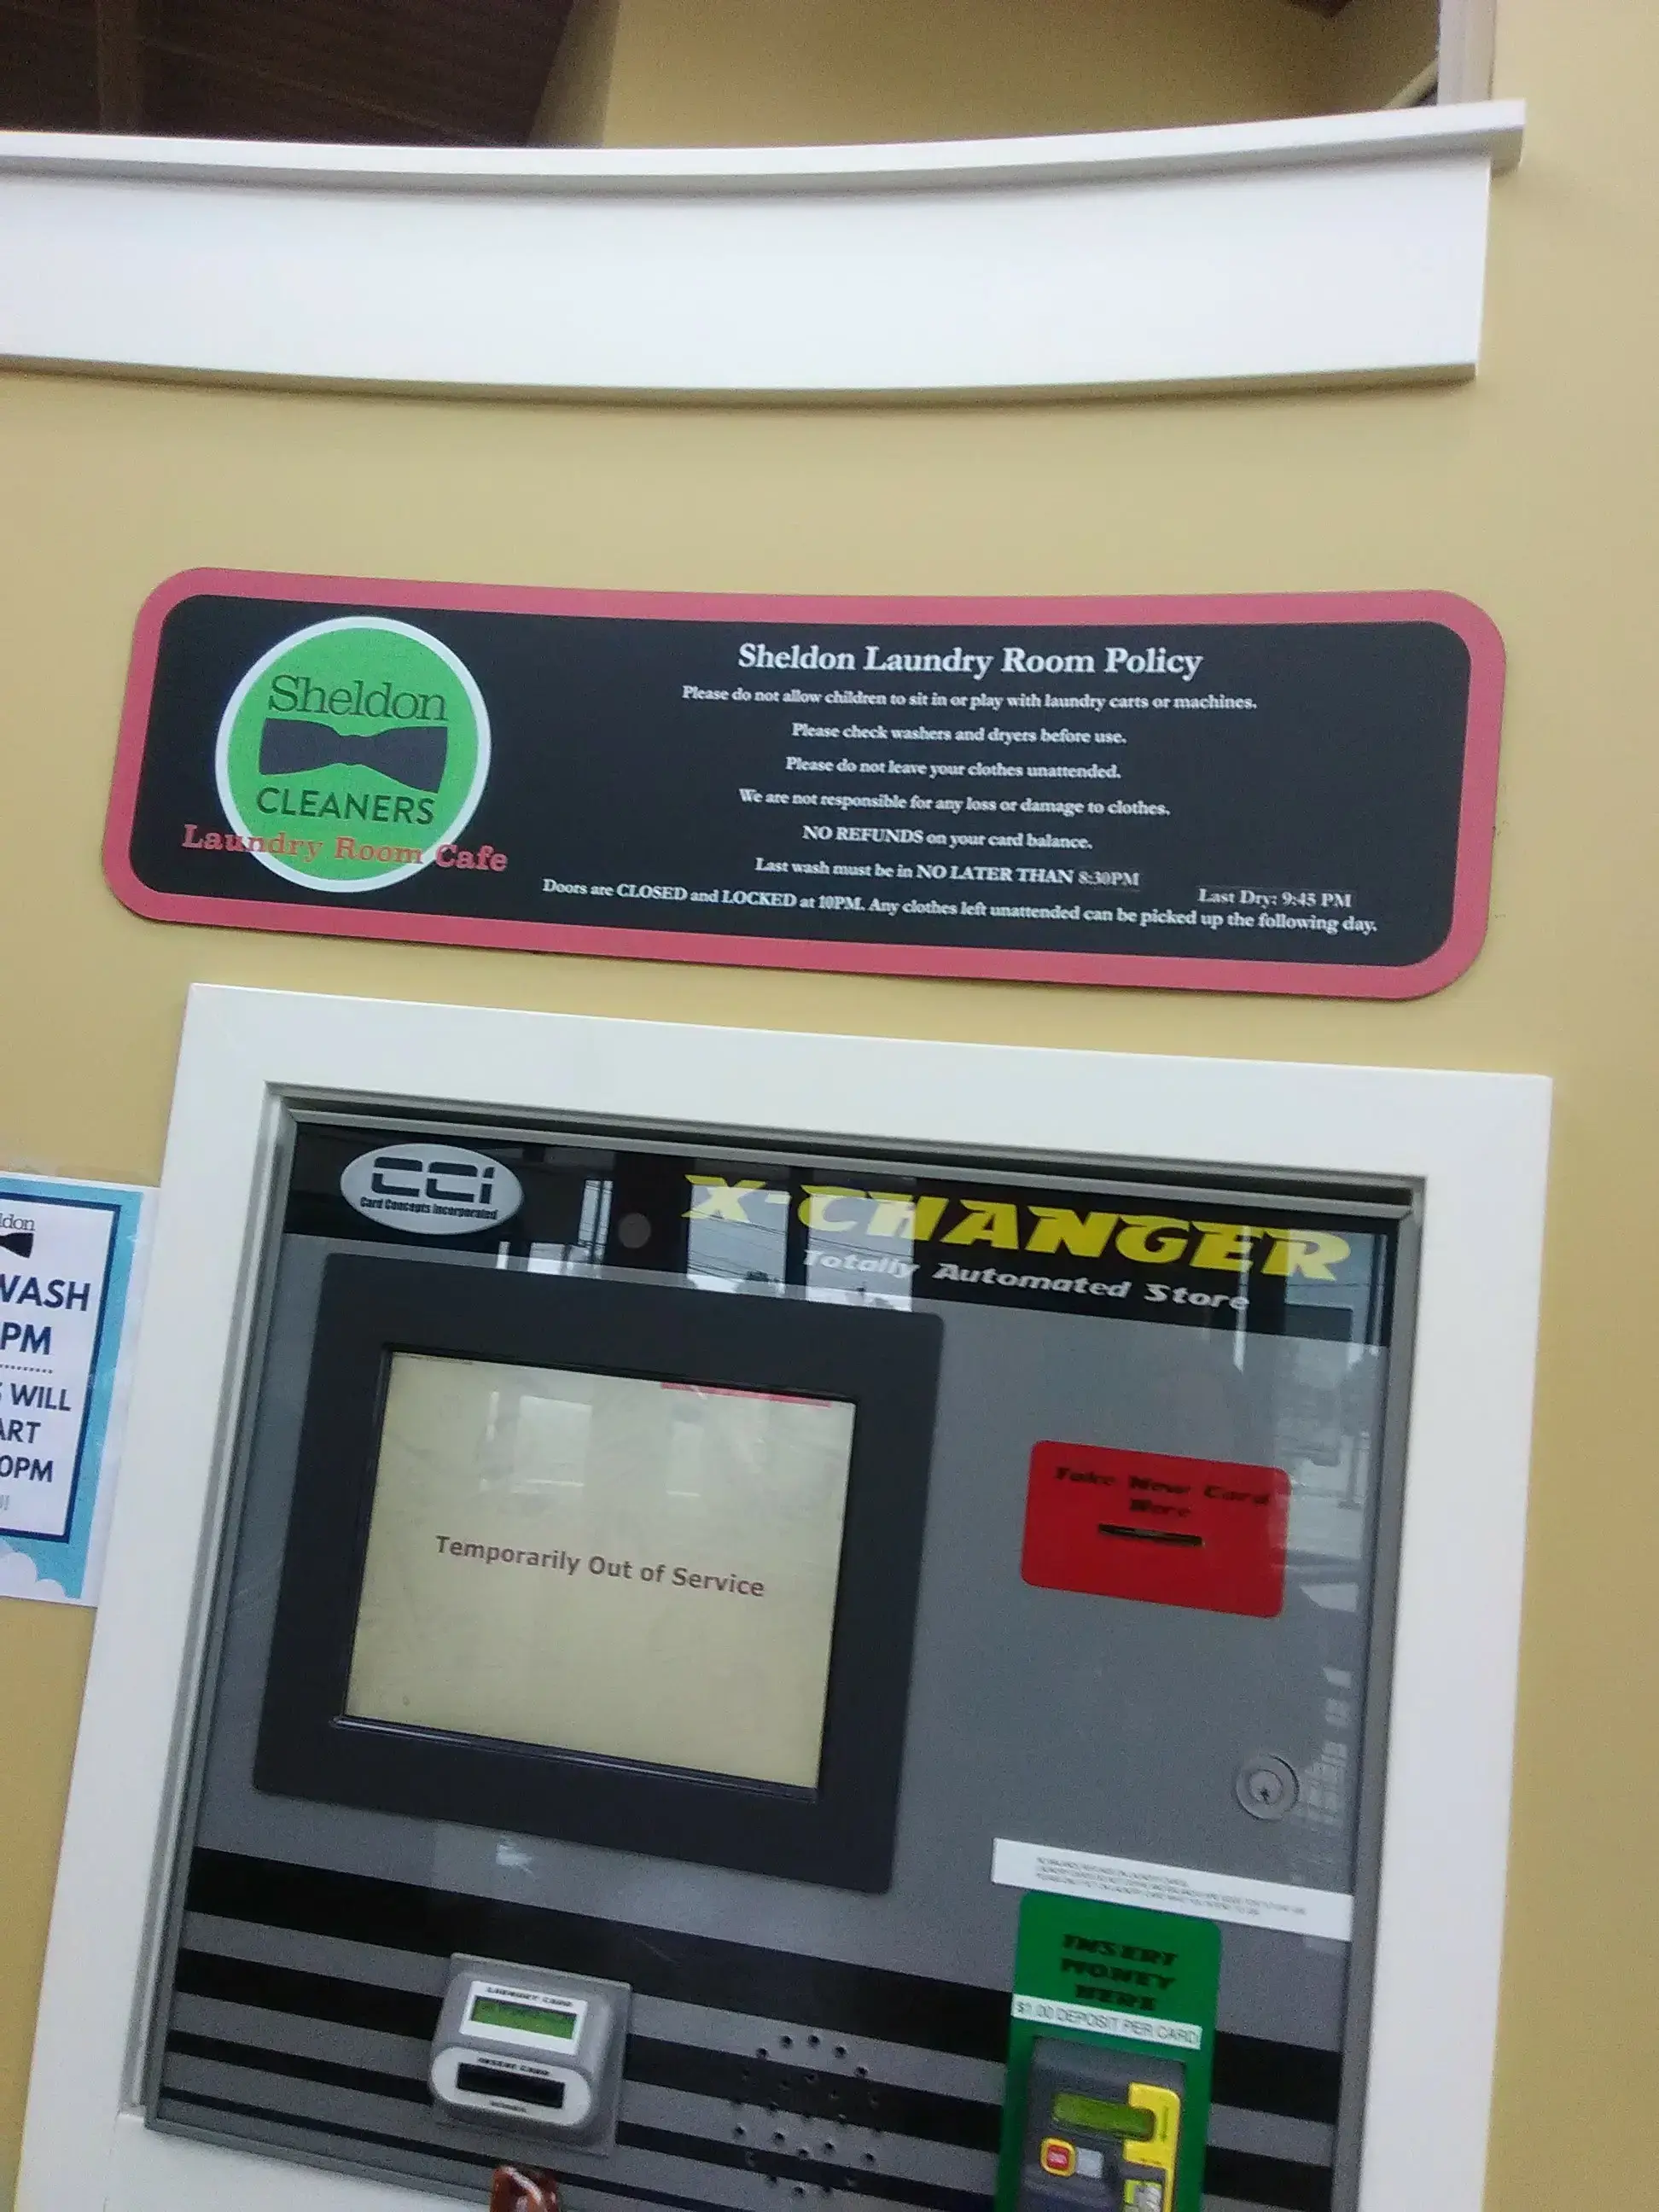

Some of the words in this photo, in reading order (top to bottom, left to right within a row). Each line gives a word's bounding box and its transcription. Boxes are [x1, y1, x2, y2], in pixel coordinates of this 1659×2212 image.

[738, 643, 855, 671] Sheldon
[864, 646, 993, 680] Laundry
[1002, 648, 1095, 673] Room
[1104, 648, 1203, 681] Policy
[267, 674, 448, 721] Sheldon
[683, 685, 729, 701] Please
[732, 688, 752, 701] do
[755, 690, 779, 702] not
[783, 689, 822, 704] allow
[824, 690, 887, 706] children
[890, 693, 905, 707] to
[909, 692, 928, 707] sit
[932, 692, 947, 707] in
[951, 696, 967, 707] or
[970, 692, 1004, 711] play
[1007, 694, 1041, 709] with
[1045, 694, 1106, 713] laundry
[1109, 696, 1149, 709] carts
[1152, 697, 1170, 709] or
[1173, 695, 1258, 710] machines.
[792, 723, 840, 739] Please
[843, 725, 888, 740] check
[891, 725, 952, 742] washers
[955, 728, 985, 742] and
[987, 728, 1037, 746] dryers
[1040, 728, 1091, 743] before
[1095, 731, 1126, 744] use.
[786, 757, 834, 772] Please
[836, 760, 857, 773] do
[859, 760, 885, 773] not
[888, 760, 927, 775] leave
[929, 764, 965, 779] your
[968, 763, 1023, 777] clothes
[1027, 763, 1121, 779] unattended.
[257, 787, 434, 825] CLEANERS
[739, 789, 762, 805] We
[765, 792, 789, 806] are
[792, 793, 818, 806] not
[821, 795, 907, 811] responsible
[910, 795, 933, 809] for
[935, 799, 963, 813] any
[966, 798, 997, 812] loss
[999, 800, 1017, 812] or
[1021, 799, 1085, 816] damage
[1087, 801, 1104, 814] to
[1108, 800, 1171, 817] clothes.
[182, 824, 323, 863] Laundry
[335, 836, 423, 864] Room
[435, 844, 509, 872] Cafe
[802, 825, 833, 842] NO
[836, 827, 923, 844] REFUNDS
[927, 832, 946, 844] on
[949, 833, 985, 849] your
[988, 831, 1023, 847] card
[1026, 833, 1093, 850] balance.
[756, 858, 789, 873] Last
[792, 859, 830, 875] wash
[833, 863, 870, 876] must
[874, 863, 894, 877] be
[897, 863, 914, 878] in
[917, 864, 947, 881] NO
[951, 865, 1013, 882] LATER
[1016, 867, 1074, 884] THAN
[543, 878, 587, 894] Doors
[591, 883, 614, 896] are
[616, 883, 688, 900] CLOSED
[690, 888, 719, 904] and
[722, 889, 797, 907] LOCKED
[800, 896, 815, 909] at
[818, 894, 865, 911] 10PM.
[868, 897, 899, 916] Any
[902, 899, 958, 915] clothes
[960, 901, 987, 917] left
[990, 903, 1080, 921] unattended
[1083, 910, 1113, 923] can
[1116, 908, 1137, 923] be
[1140, 909, 1197, 928] picked
[1201, 914, 1224, 928] up
[1226, 912, 1255, 928] the
[1258, 913, 1338, 933] following
[1342, 917, 1378, 934] day.
[1197, 888, 1235, 905] Last
[1239, 889, 1278, 910] Dry:
[1282, 891, 1317, 908] 9:45
[1321, 893, 1353, 909] PM
[360, 1196, 383, 1208] Card
[385, 1198, 430, 1214] Concepts
[433, 1203, 498, 1220] Incorporated
[803, 1249, 920, 1278] Totally
[932, 1263, 1132, 1299] Automated
[1144, 1283, 1250, 1311] Store
[10, 1383, 72, 1412] WILL
[434, 1535, 580, 1575] Temporarily
[588, 1556, 632, 1580] Out
[640, 1563, 667, 1583] of
[672, 1568, 765, 1598] Service
